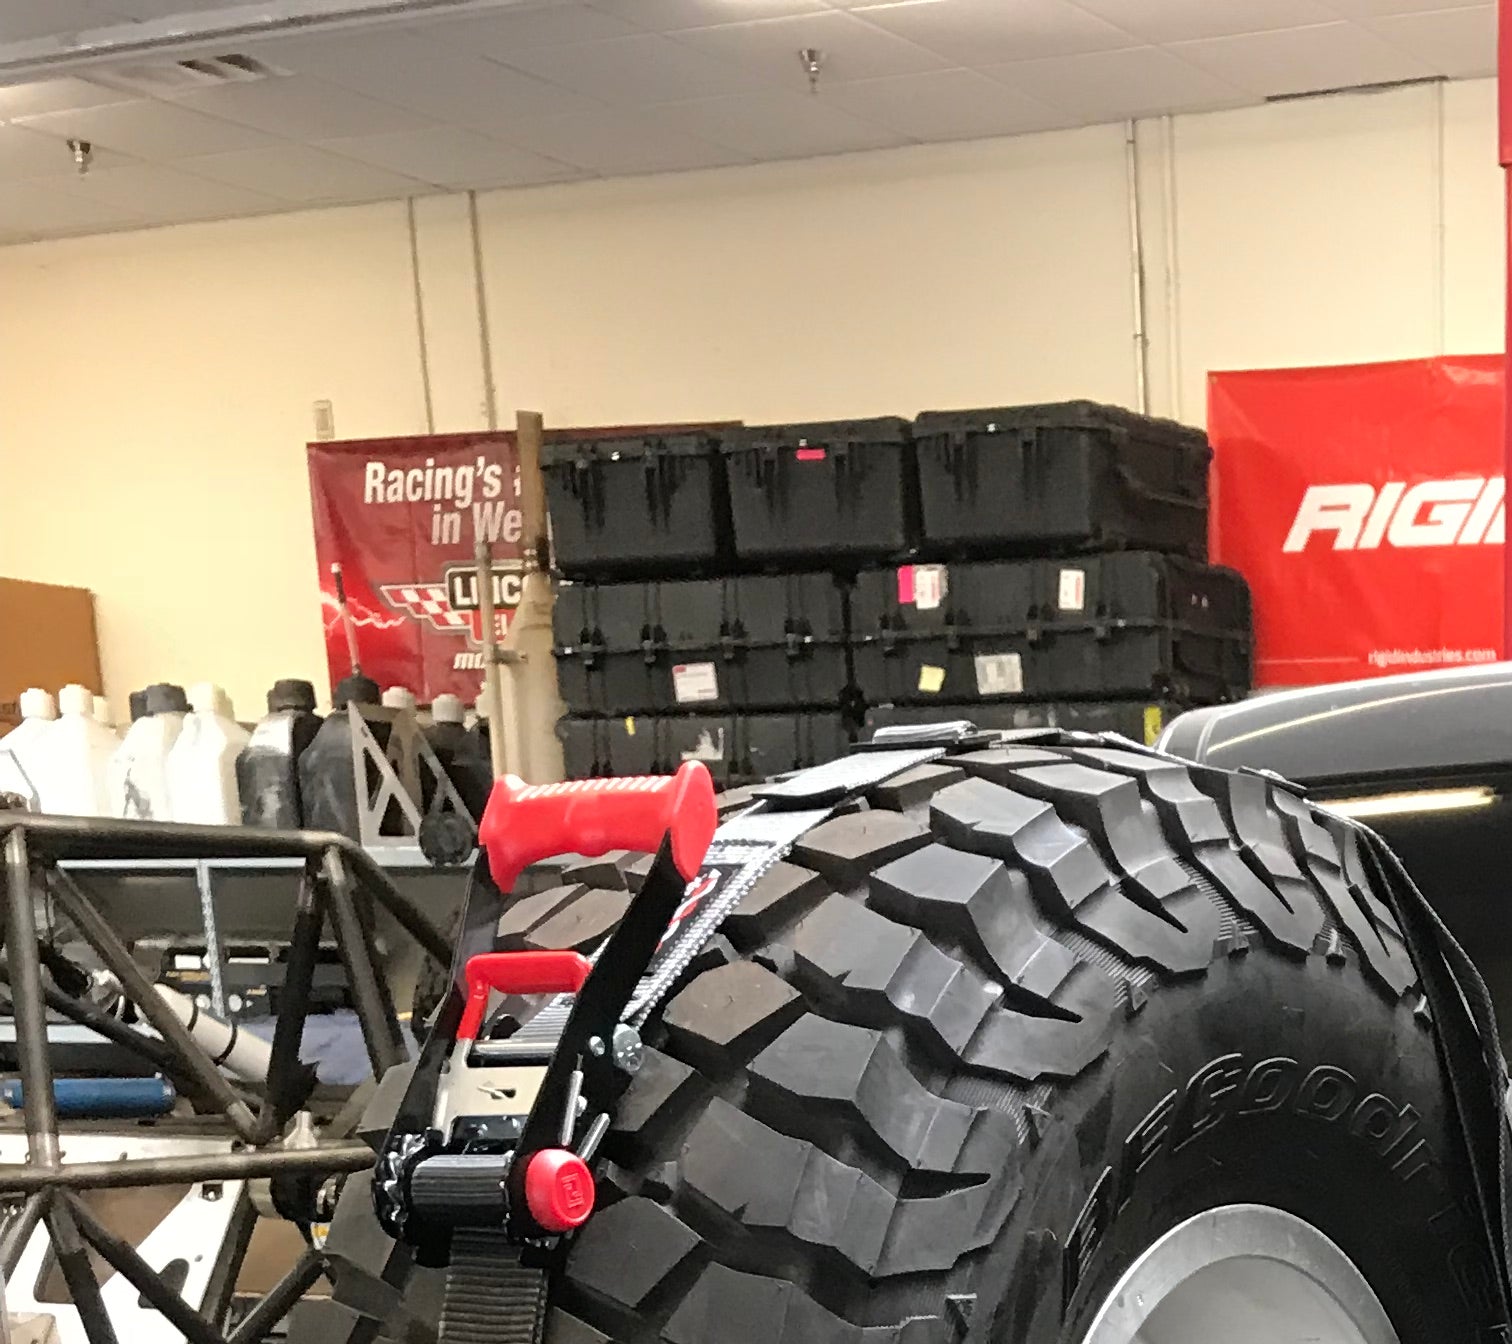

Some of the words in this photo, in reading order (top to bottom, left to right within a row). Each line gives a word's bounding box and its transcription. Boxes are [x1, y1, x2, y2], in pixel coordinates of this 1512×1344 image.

[364, 456, 502, 508] Racing's
[431, 503, 461, 545] in
[1282, 475, 1506, 553] RIGI
